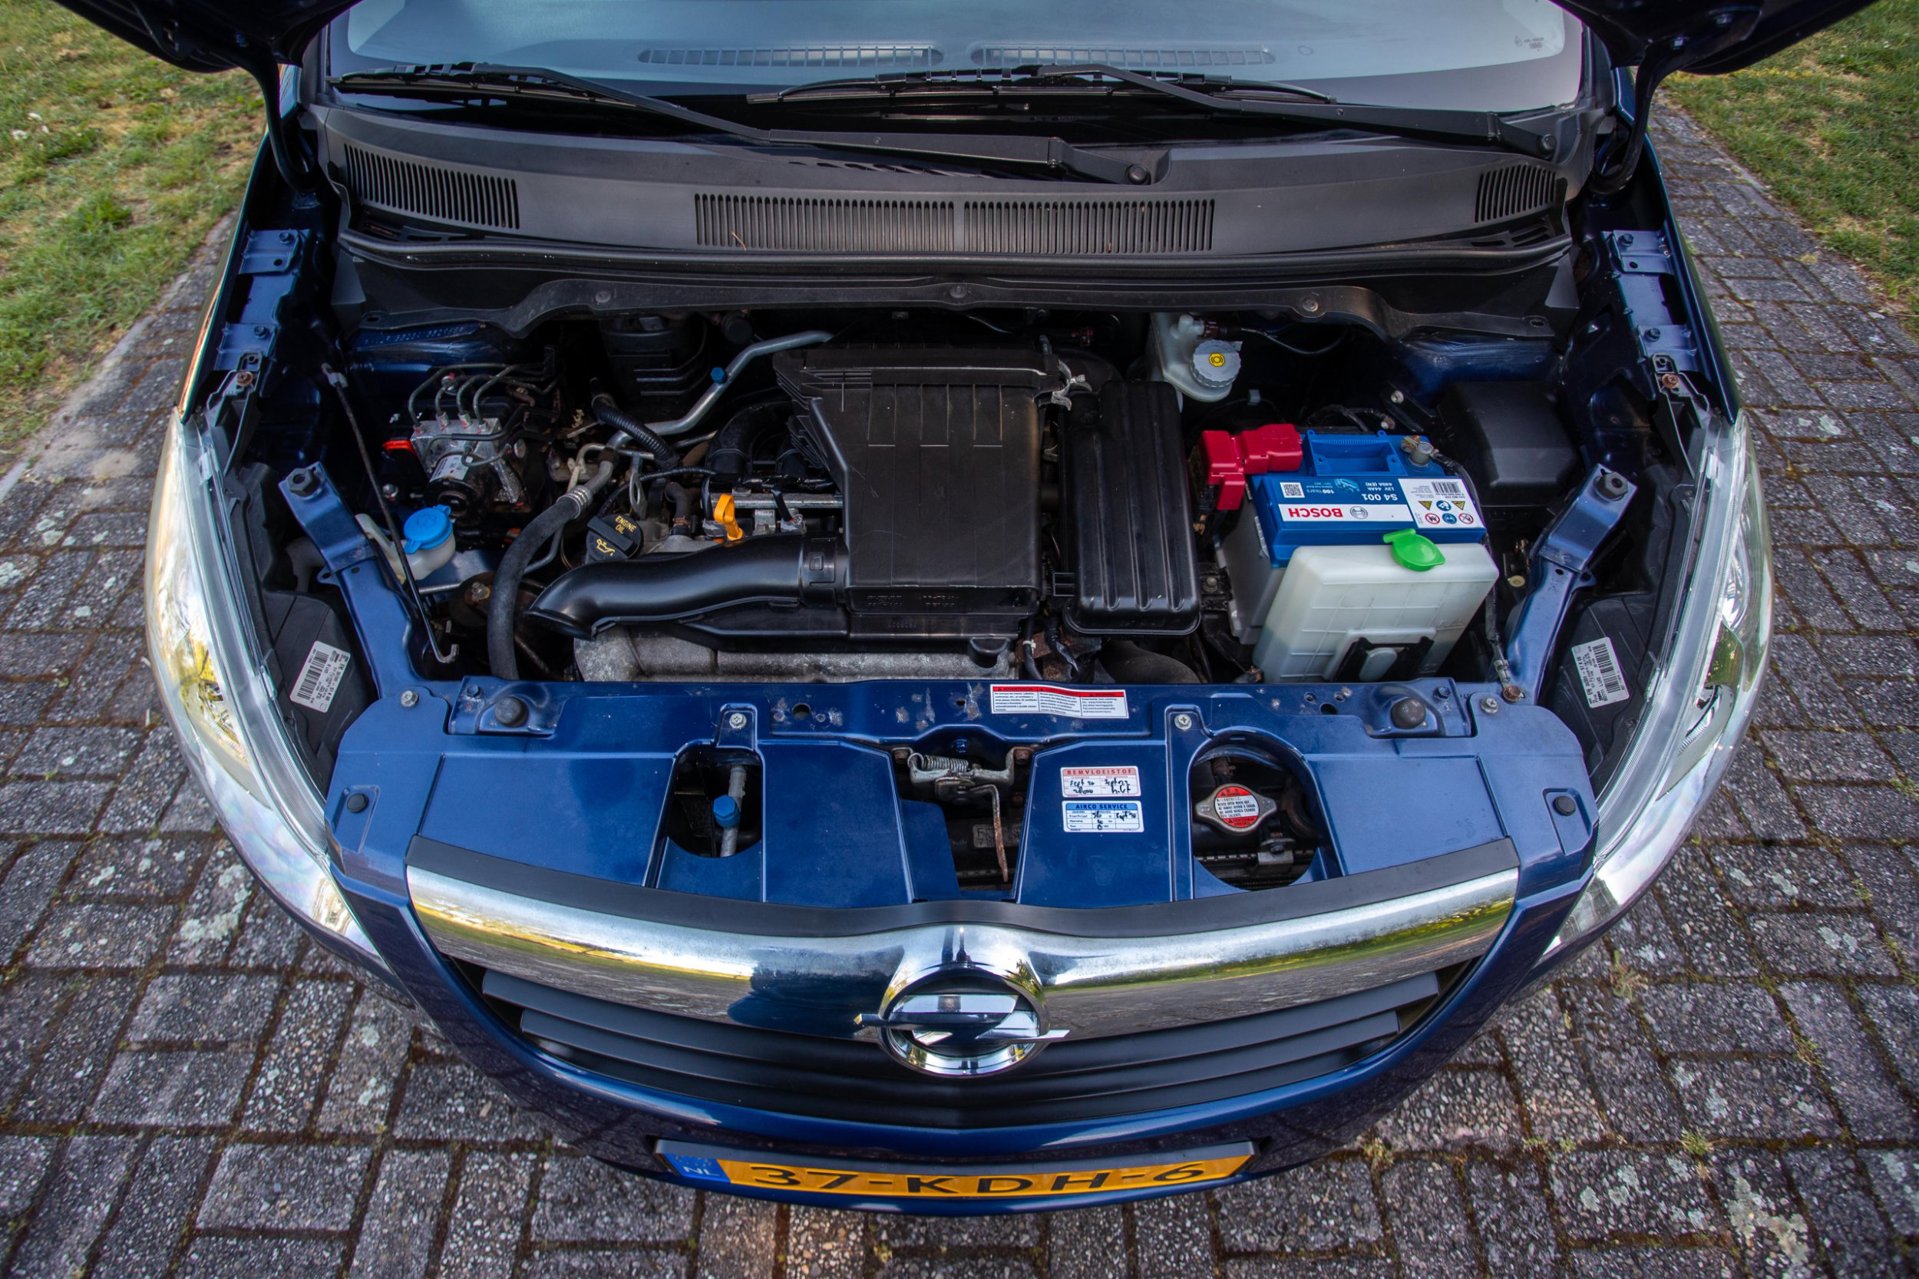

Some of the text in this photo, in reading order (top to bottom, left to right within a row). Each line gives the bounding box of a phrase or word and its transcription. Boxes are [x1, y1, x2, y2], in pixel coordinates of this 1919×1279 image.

[1361, 493, 1398, 501] S4 001
[1288, 507, 1343, 518] BOSCH
[615, 515, 637, 533] ENGINE
[683, 1166, 720, 1177] NL
[751, 1163, 1204, 1194] 37-KDH-6
